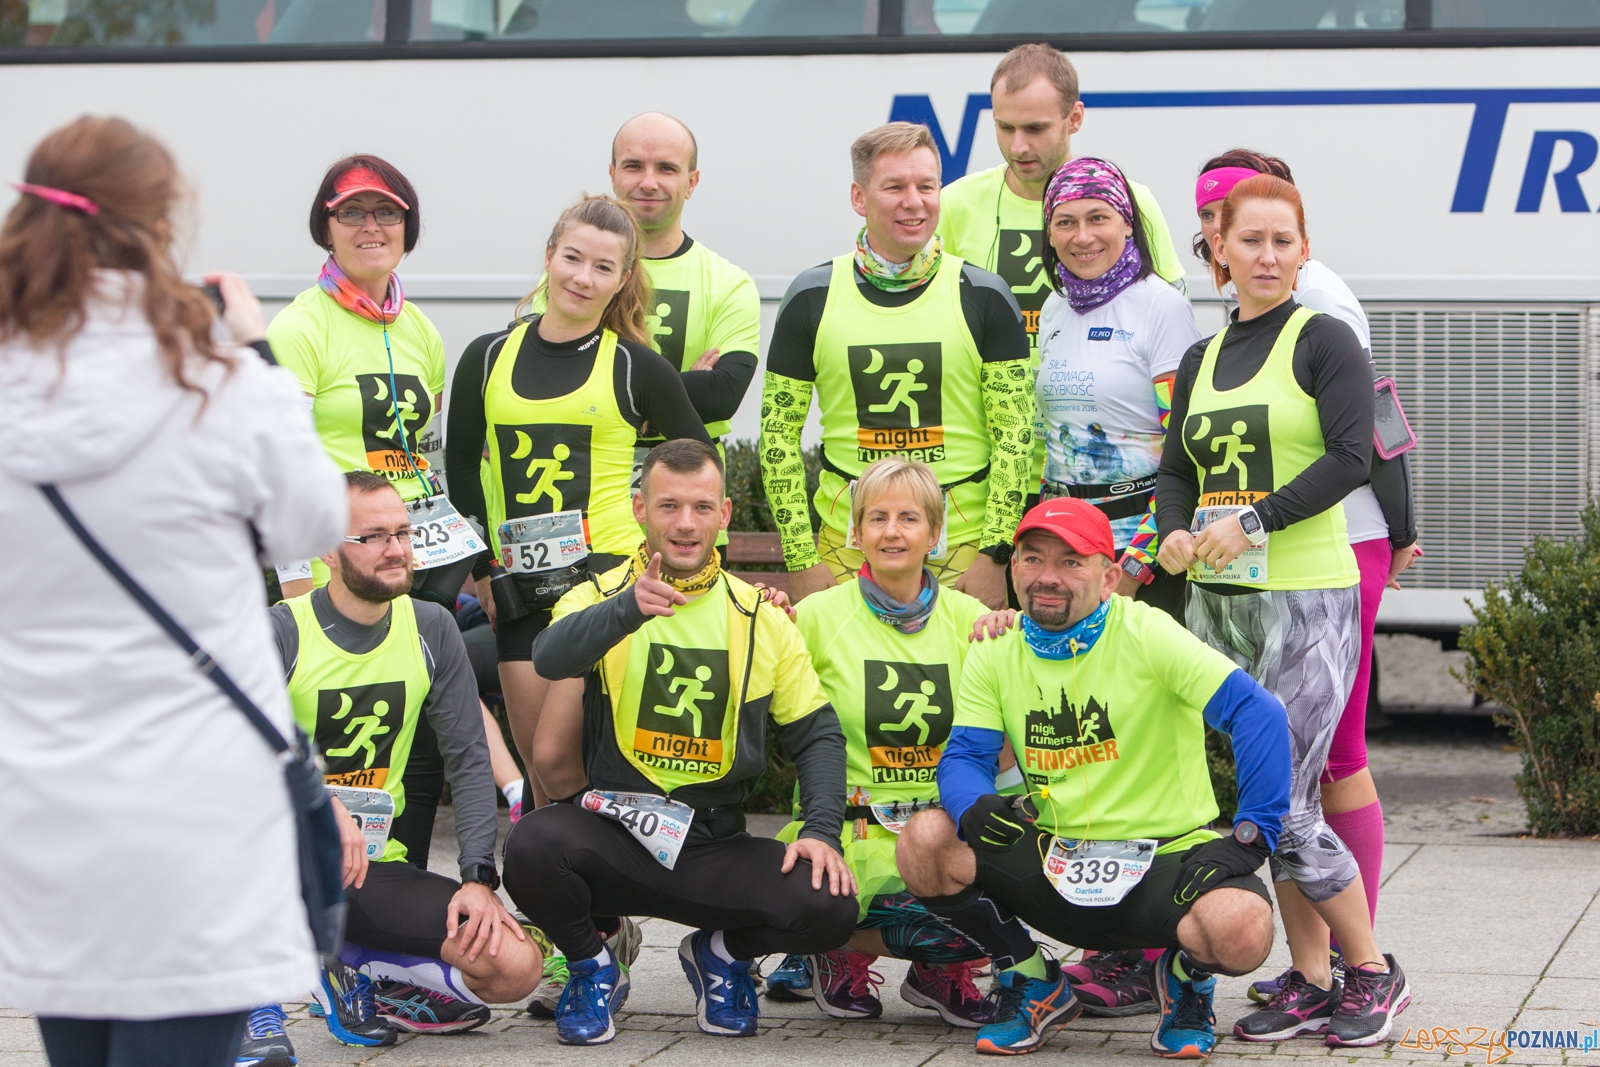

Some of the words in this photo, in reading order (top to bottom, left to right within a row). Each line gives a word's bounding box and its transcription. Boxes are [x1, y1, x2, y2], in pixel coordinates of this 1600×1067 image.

[1450, 88, 1600, 212] TR
[1047, 359, 1068, 370] SIŁA
[1049, 371, 1095, 382] ODWAGA
[1043, 383, 1095, 397] SZYBKOŚĆ
[1082, 404, 1098, 412] 2016
[874, 429, 930, 449] night
[858, 446, 946, 463] runners
[426, 547, 447, 558] Dorota
[446, 550, 466, 561] POLSKA
[520, 542, 552, 570] 52
[652, 734, 709, 759] night
[1025, 739, 1120, 772] FINISHER
[885, 746, 934, 767] night
[604, 801, 659, 837] 540
[1066, 859, 1121, 885] 339
[1074, 887, 1104, 896] Dariusz
